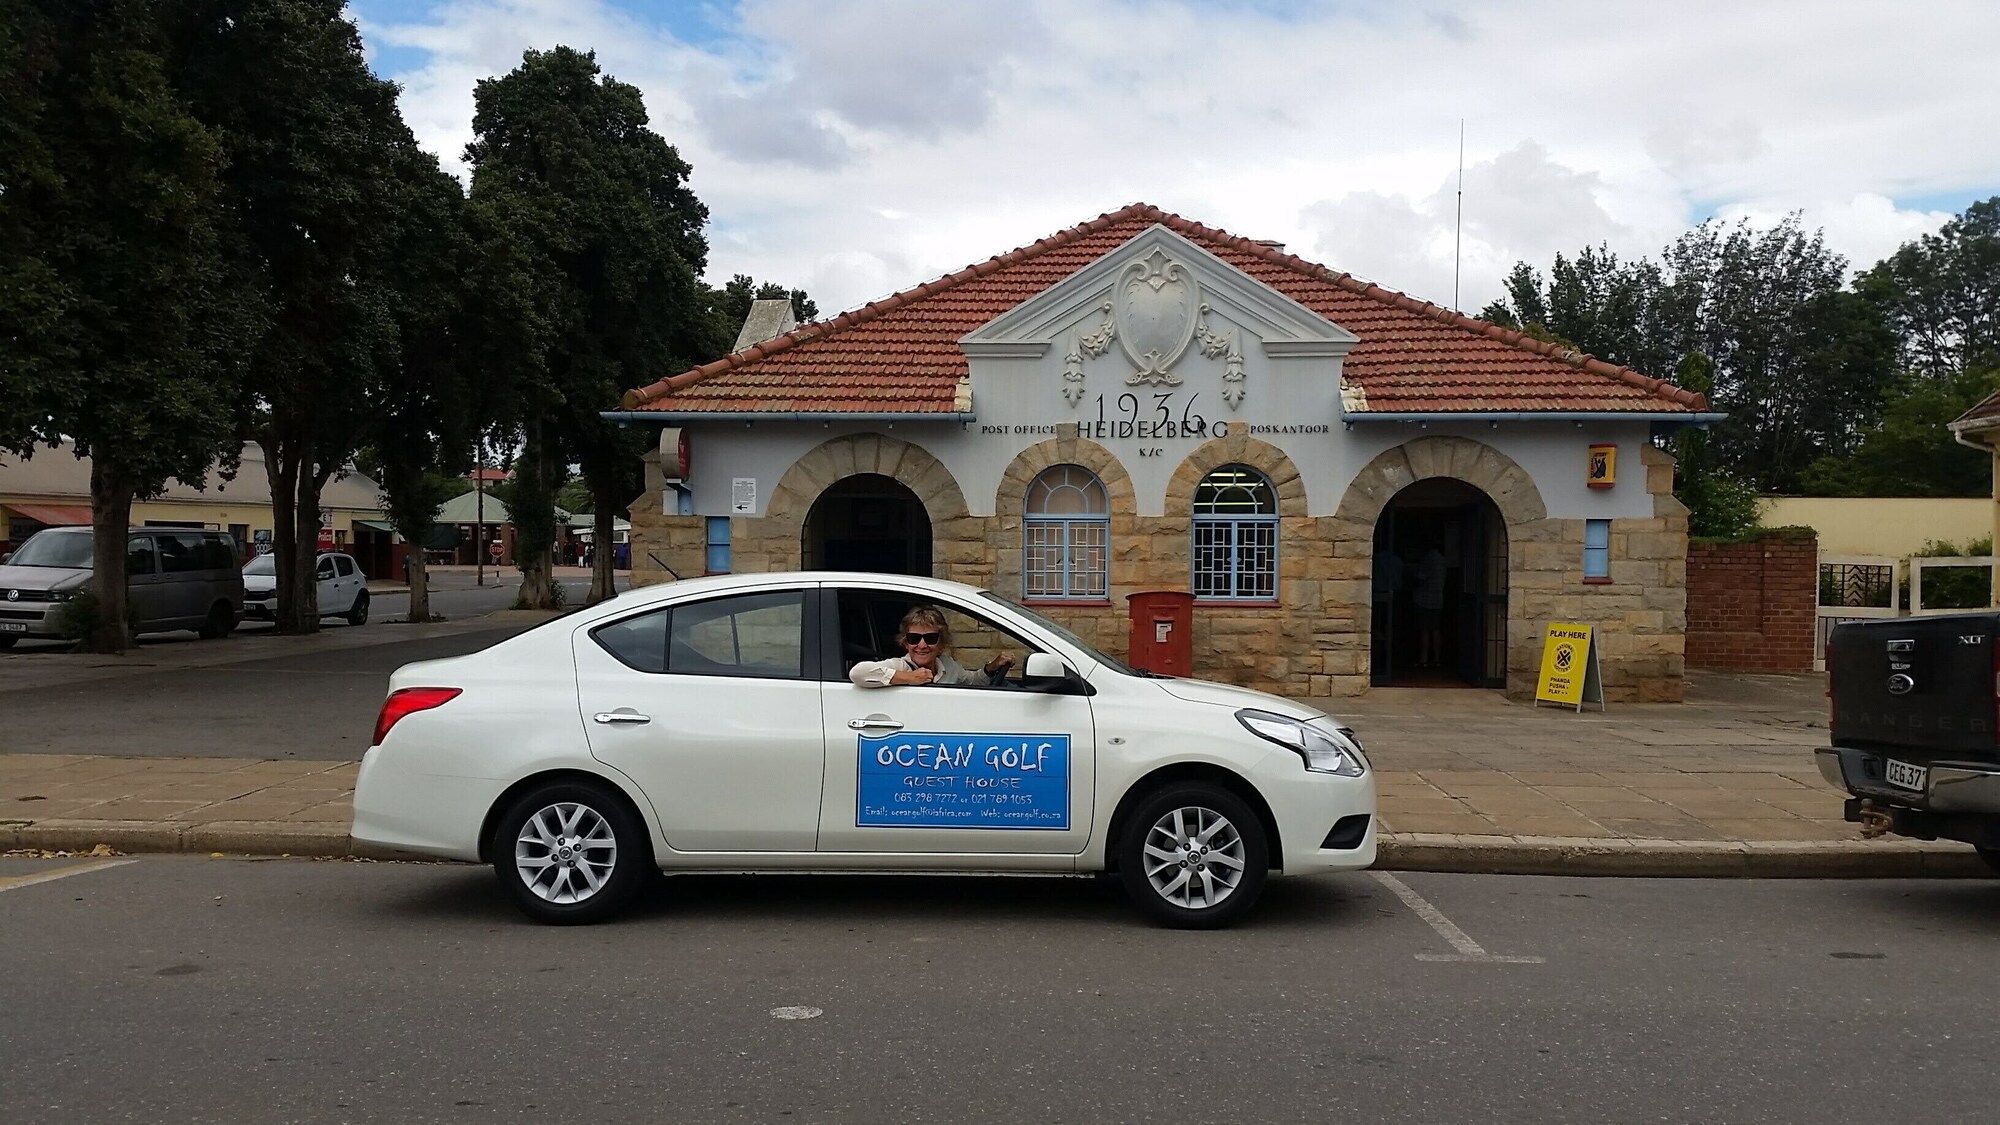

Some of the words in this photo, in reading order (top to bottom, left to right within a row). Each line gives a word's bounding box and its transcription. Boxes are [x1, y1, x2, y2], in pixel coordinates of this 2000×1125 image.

[1096, 392, 1206, 435] 1936
[981, 425, 1009, 434] POST
[1014, 425, 1057, 434] OFFICE
[1077, 420, 1228, 438] HEIDELBERG
[1250, 424, 1329, 434] POSKANTOOR
[1139, 447, 1163, 457] K/C
[1550, 630, 1568, 638] PLAY
[1568, 631, 1586, 640] HERE
[1958, 635, 1985, 644] XLT
[877, 743, 974, 771] OCEAN
[985, 743, 1052, 772] GOLF
[1889, 762, 1905, 783] CEG
[903, 776, 959, 788] GUEST
[965, 776, 1022, 789] HOUSE
[894, 792, 912, 803] 083
[915, 792, 933, 803] 298
[935, 793, 958, 803] 7272
[971, 793, 987, 804] 021
[989, 794, 1008, 804] 789
[1010, 794, 1032, 805] 1053
[865, 806, 888, 816] Email:
[980, 808, 1000, 818] Web:
